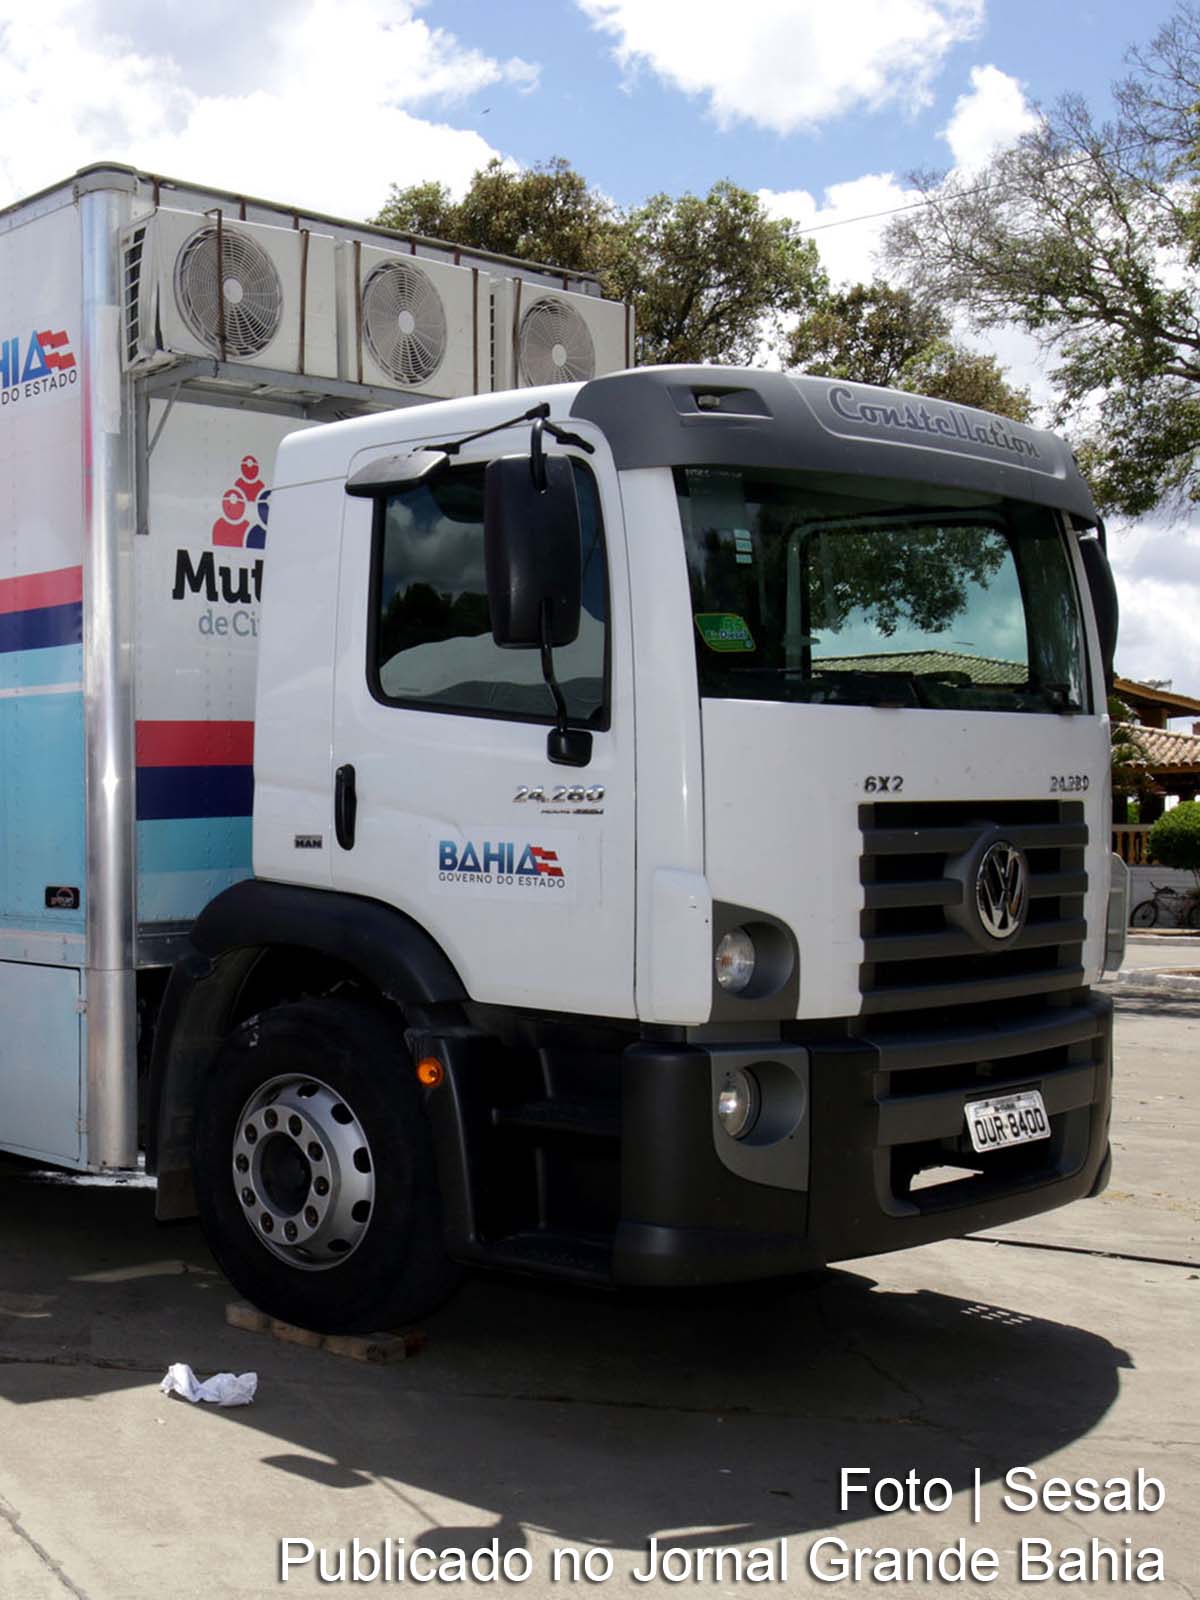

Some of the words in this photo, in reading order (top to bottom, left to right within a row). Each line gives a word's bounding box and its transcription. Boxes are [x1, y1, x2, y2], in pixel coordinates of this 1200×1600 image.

[1, 387, 20, 406] DO
[24, 368, 78, 399] ESTADO
[828, 386, 1041, 459] Constellation
[172, 549, 264, 604] Mut
[198, 608, 229, 636] de
[232, 609, 261, 638] Ci
[512, 784, 606, 804] 24.280
[439, 840, 542, 876] BAHIA
[438, 872, 493, 885] GOVERNO
[496, 875, 514, 886] DO
[518, 876, 566, 889] ESTADO
